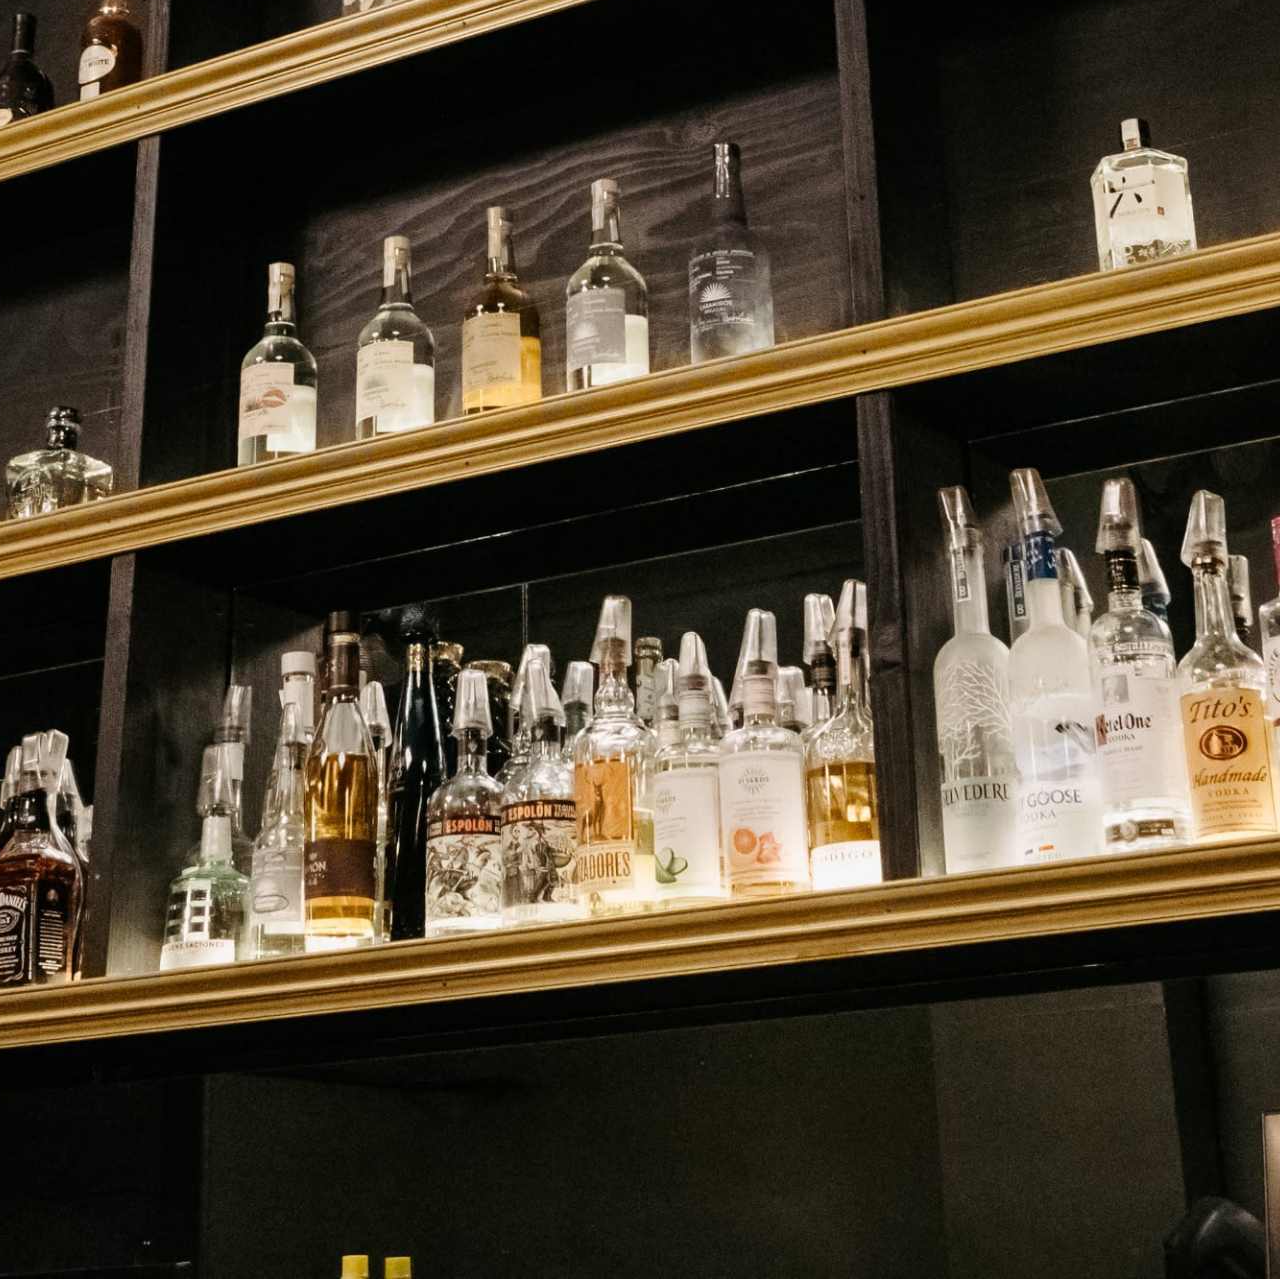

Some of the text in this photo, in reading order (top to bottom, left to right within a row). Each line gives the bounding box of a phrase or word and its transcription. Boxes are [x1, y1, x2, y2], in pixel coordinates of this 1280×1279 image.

[1124, 712, 1152, 730] One
[1189, 694, 1252, 724] Tito's
[1192, 765, 1268, 790] Handmade
[942, 782, 1009, 807] ELVEDERE
[1026, 788, 1083, 808] GOOSE
